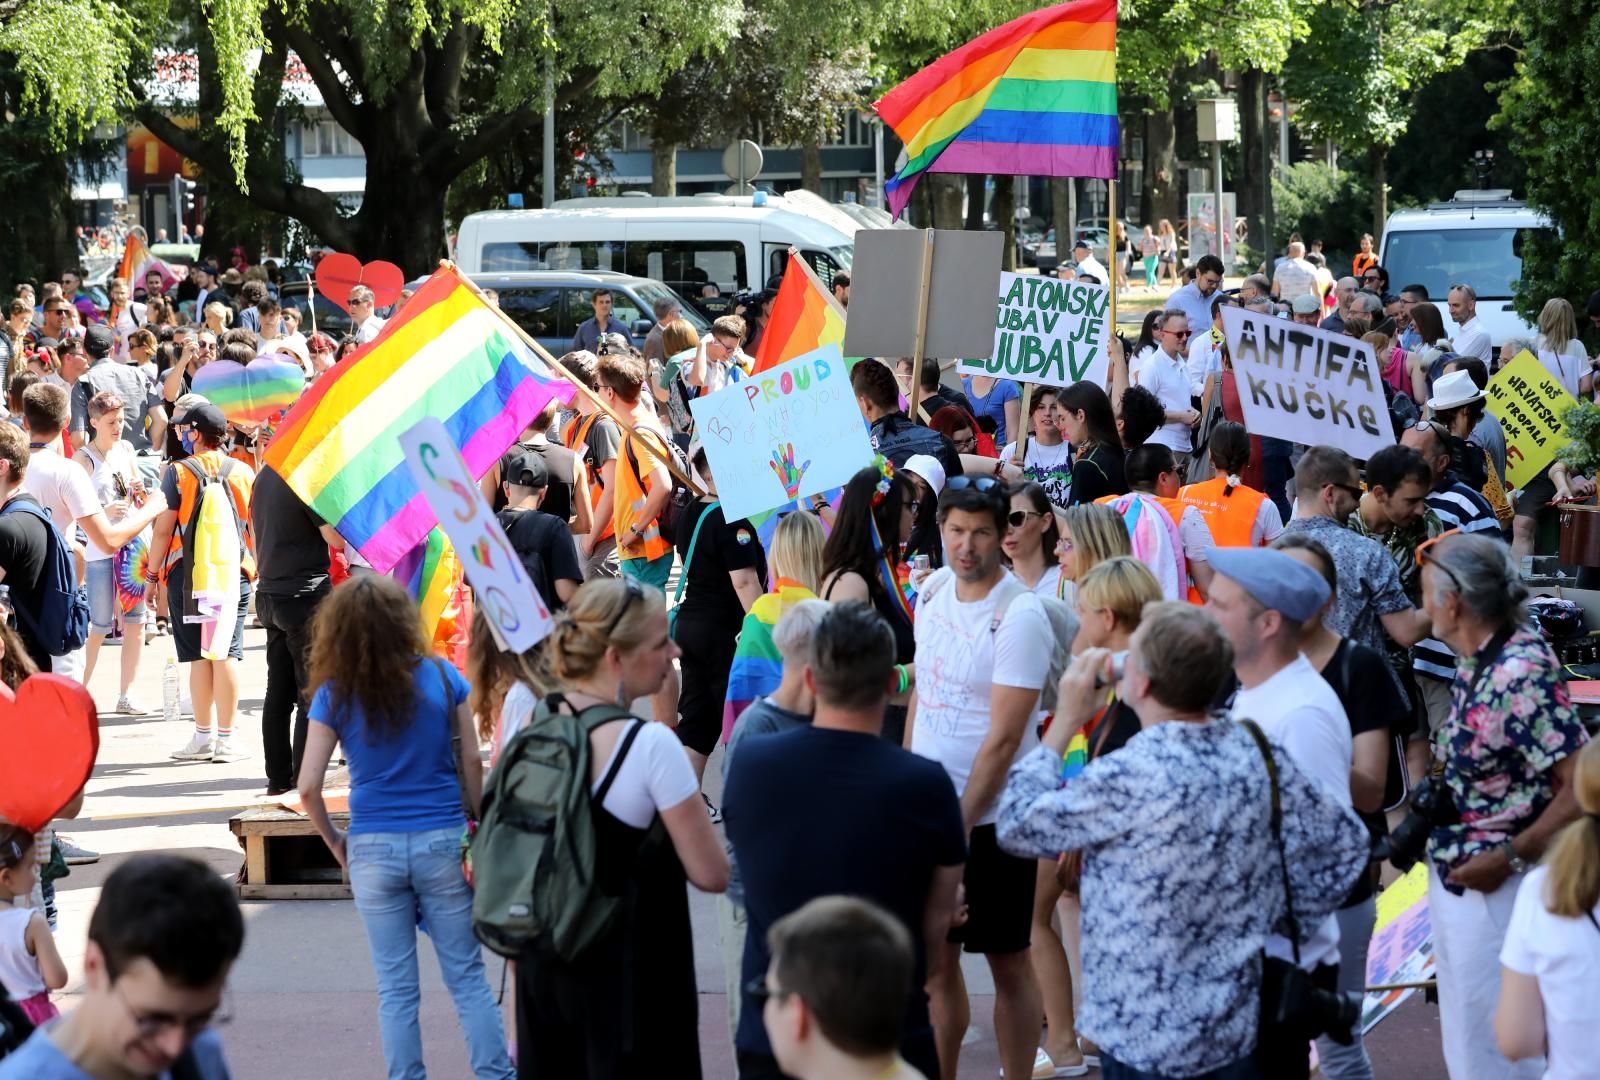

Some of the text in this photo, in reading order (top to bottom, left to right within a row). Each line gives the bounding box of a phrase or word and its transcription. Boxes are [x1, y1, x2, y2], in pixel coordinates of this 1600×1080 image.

[1069, 317, 1103, 345] JE
[962, 332, 1098, 382] JUBAV
[1236, 319, 1374, 393] ANTIFA
[744, 359, 831, 412] PROUD
[808, 387, 840, 417] YOU
[1508, 375, 1562, 434] HRVATSKA
[1540, 380, 1563, 400] JOŠ
[1499, 416, 1520, 440] DOK
[1505, 401, 1547, 447] PROPALA
